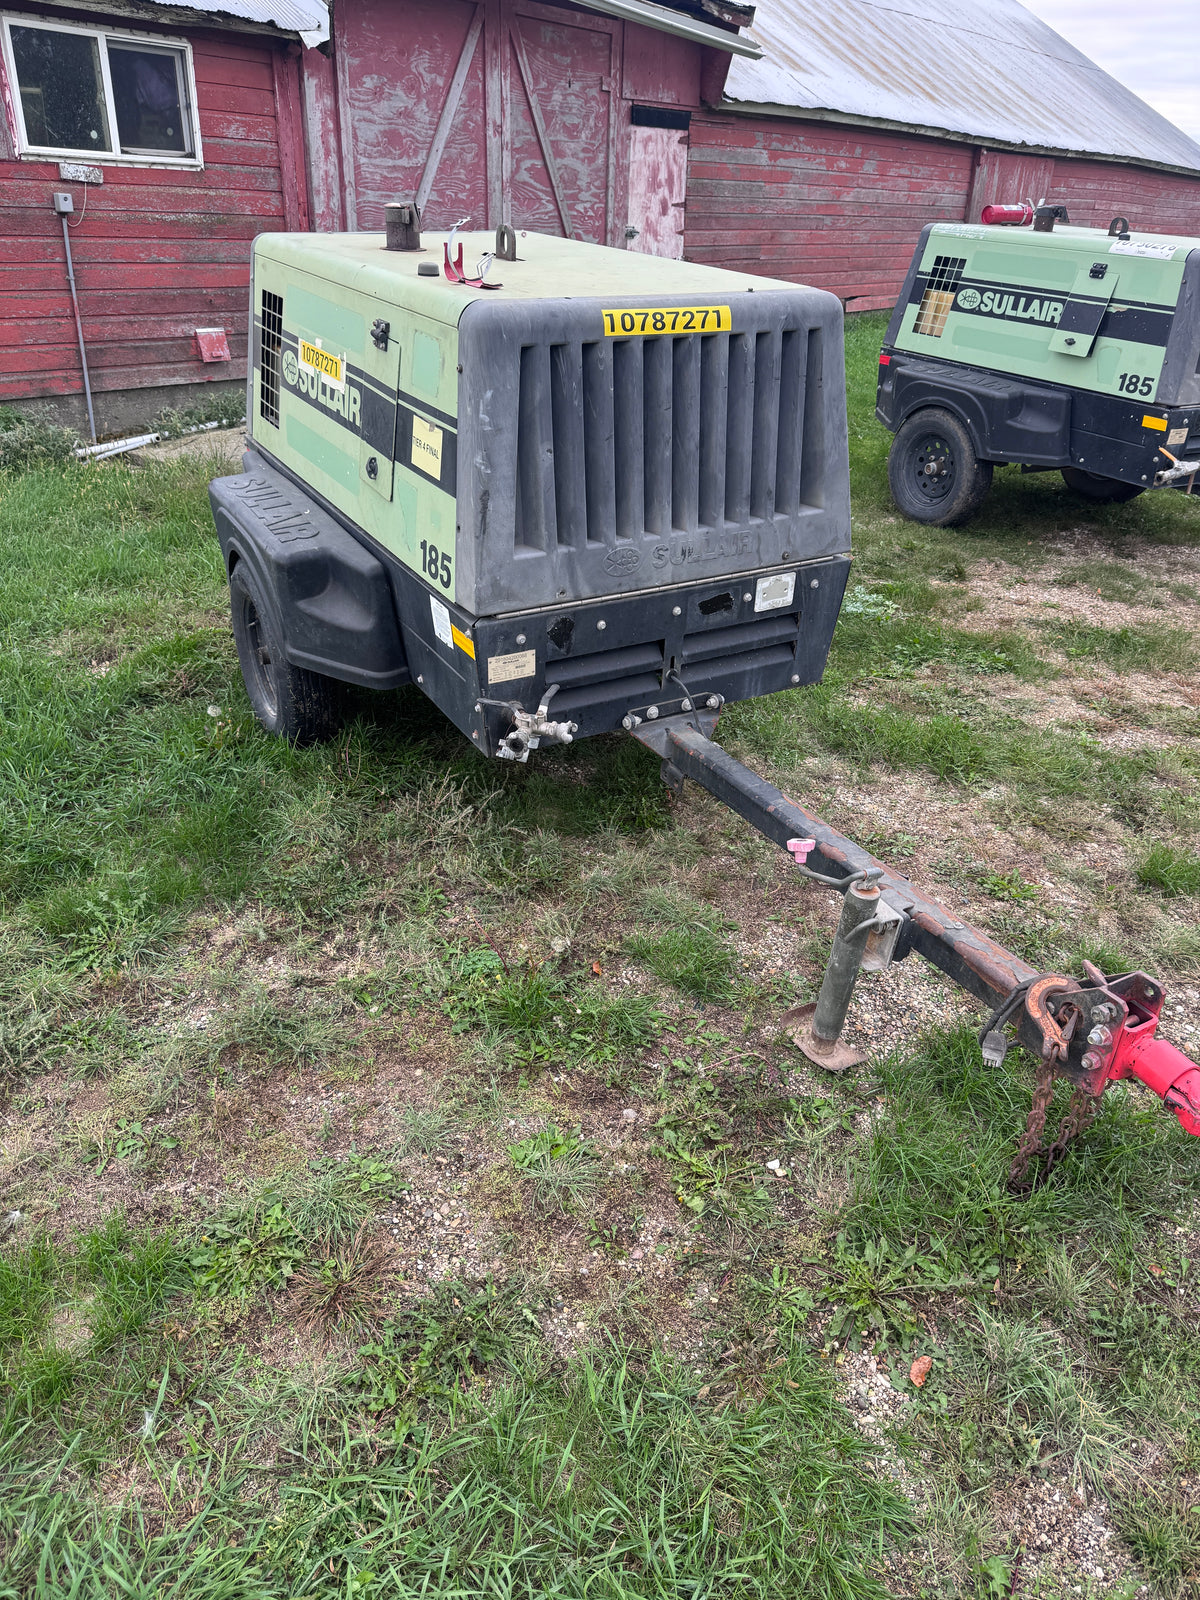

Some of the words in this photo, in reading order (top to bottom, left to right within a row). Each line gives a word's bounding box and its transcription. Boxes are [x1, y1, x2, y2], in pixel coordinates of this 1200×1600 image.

[605, 309, 721, 333] 10787271
[980, 291, 1064, 323] SULLAIR
[302, 344, 338, 378] 10787271
[1118, 373, 1155, 397] 185
[420, 539, 452, 589] 185
